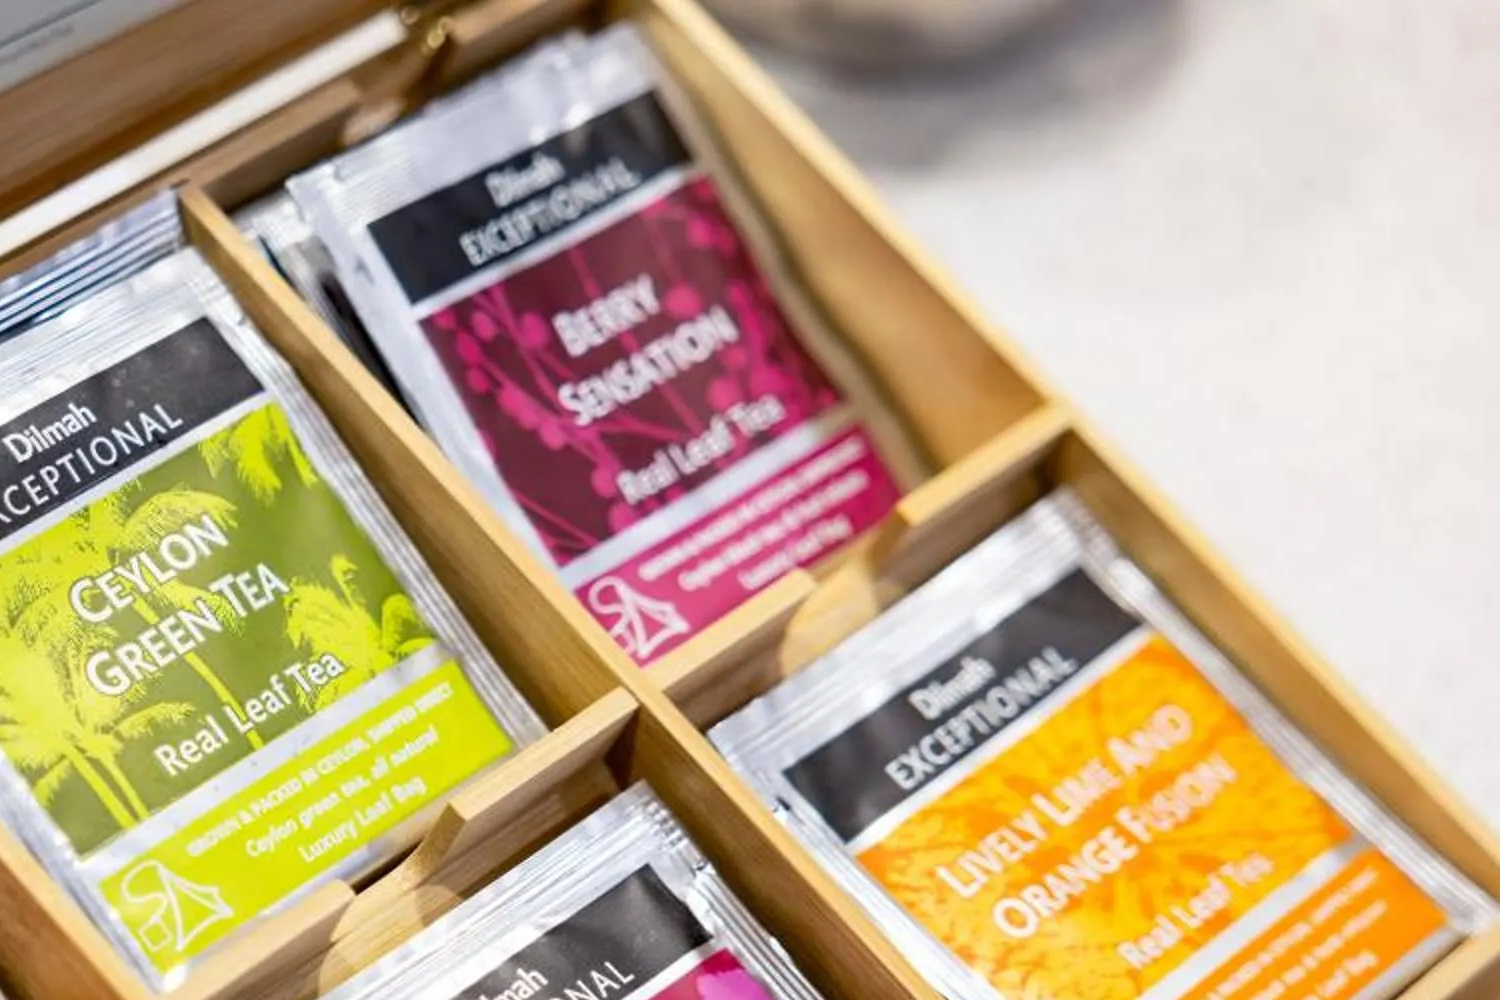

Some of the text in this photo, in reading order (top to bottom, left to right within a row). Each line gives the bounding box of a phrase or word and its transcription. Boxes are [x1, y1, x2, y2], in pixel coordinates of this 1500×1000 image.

[459, 157, 643, 266] EXCEPTIONAL
[485, 152, 566, 207] Dilmah
[552, 273, 662, 358] BERRY
[556, 304, 741, 426] SENSATION
[2, 401, 97, 463] Dilmah
[615, 393, 787, 505] Real Leaf Tea
[68, 511, 230, 625] CEYLON
[84, 561, 291, 699] GREEN TEA
[153, 651, 347, 779] Real Leaf Tea
[884, 646, 1080, 791] EXCEPTIONAL
[909, 654, 997, 721] Dilmah
[245, 818, 298, 859] Ceylon
[298, 791, 342, 829] green
[371, 754, 390, 780] all
[389, 722, 439, 767] natural
[249, 777, 303, 816] PACKED
[297, 775, 429, 864] Luxury Leaf Bag
[933, 701, 1196, 900] LIVELY LIME AND
[991, 752, 1238, 939] ORANGE FUSION
[1116, 851, 1276, 971] Real Leaf Tea
